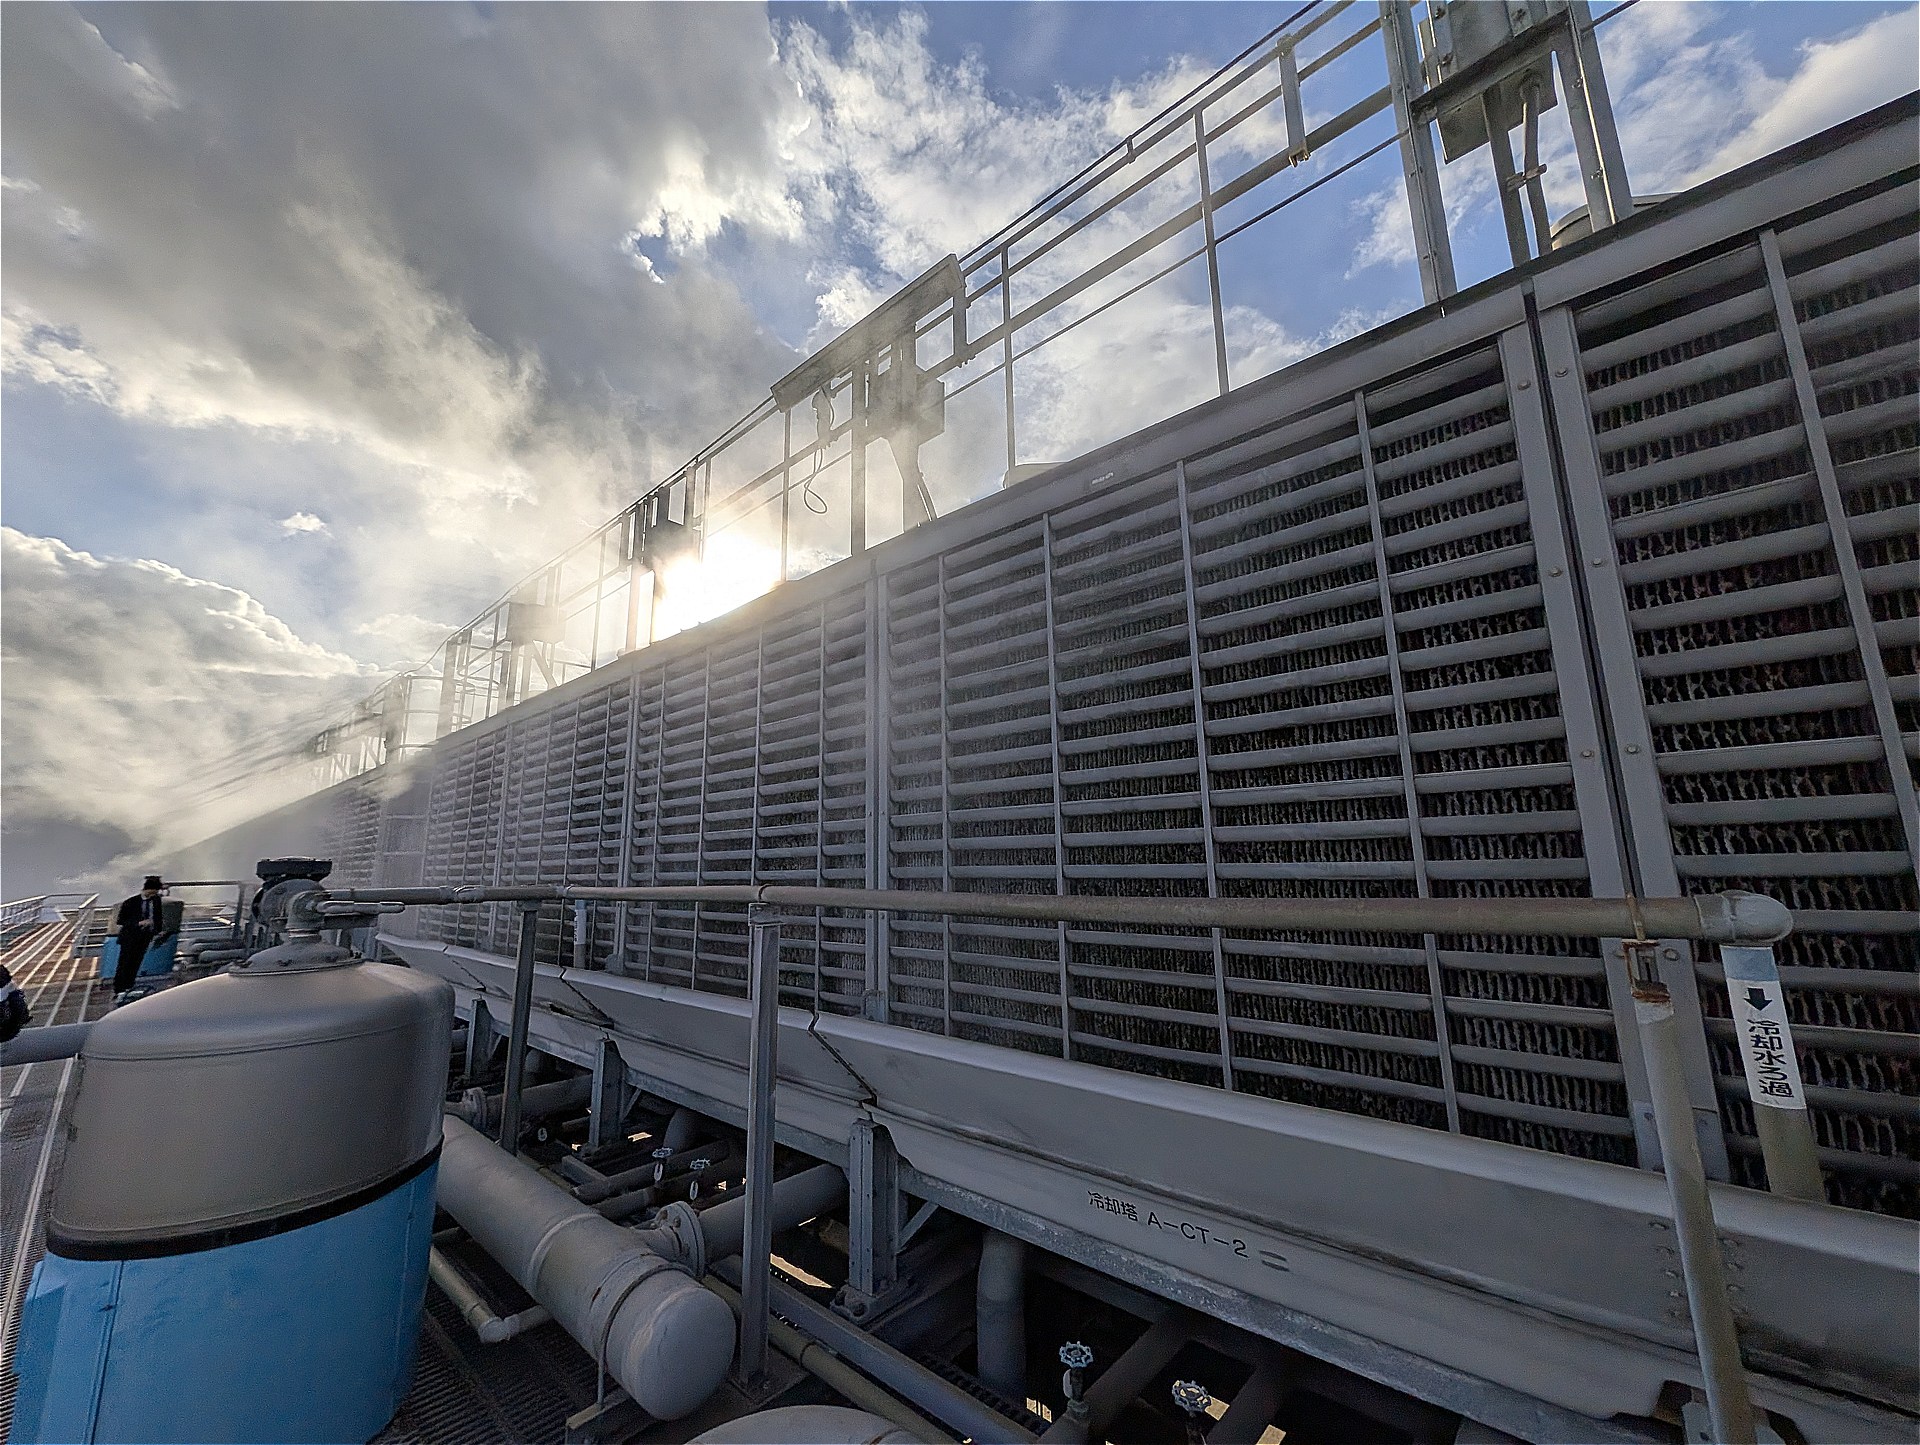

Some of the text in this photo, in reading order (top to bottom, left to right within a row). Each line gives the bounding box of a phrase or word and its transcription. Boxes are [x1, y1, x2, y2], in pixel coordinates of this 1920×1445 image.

[1746, 1019, 1795, 1098] 冷却水ろ過
[1088, 1190, 1249, 1258] 冷却塔 A-CT-2
